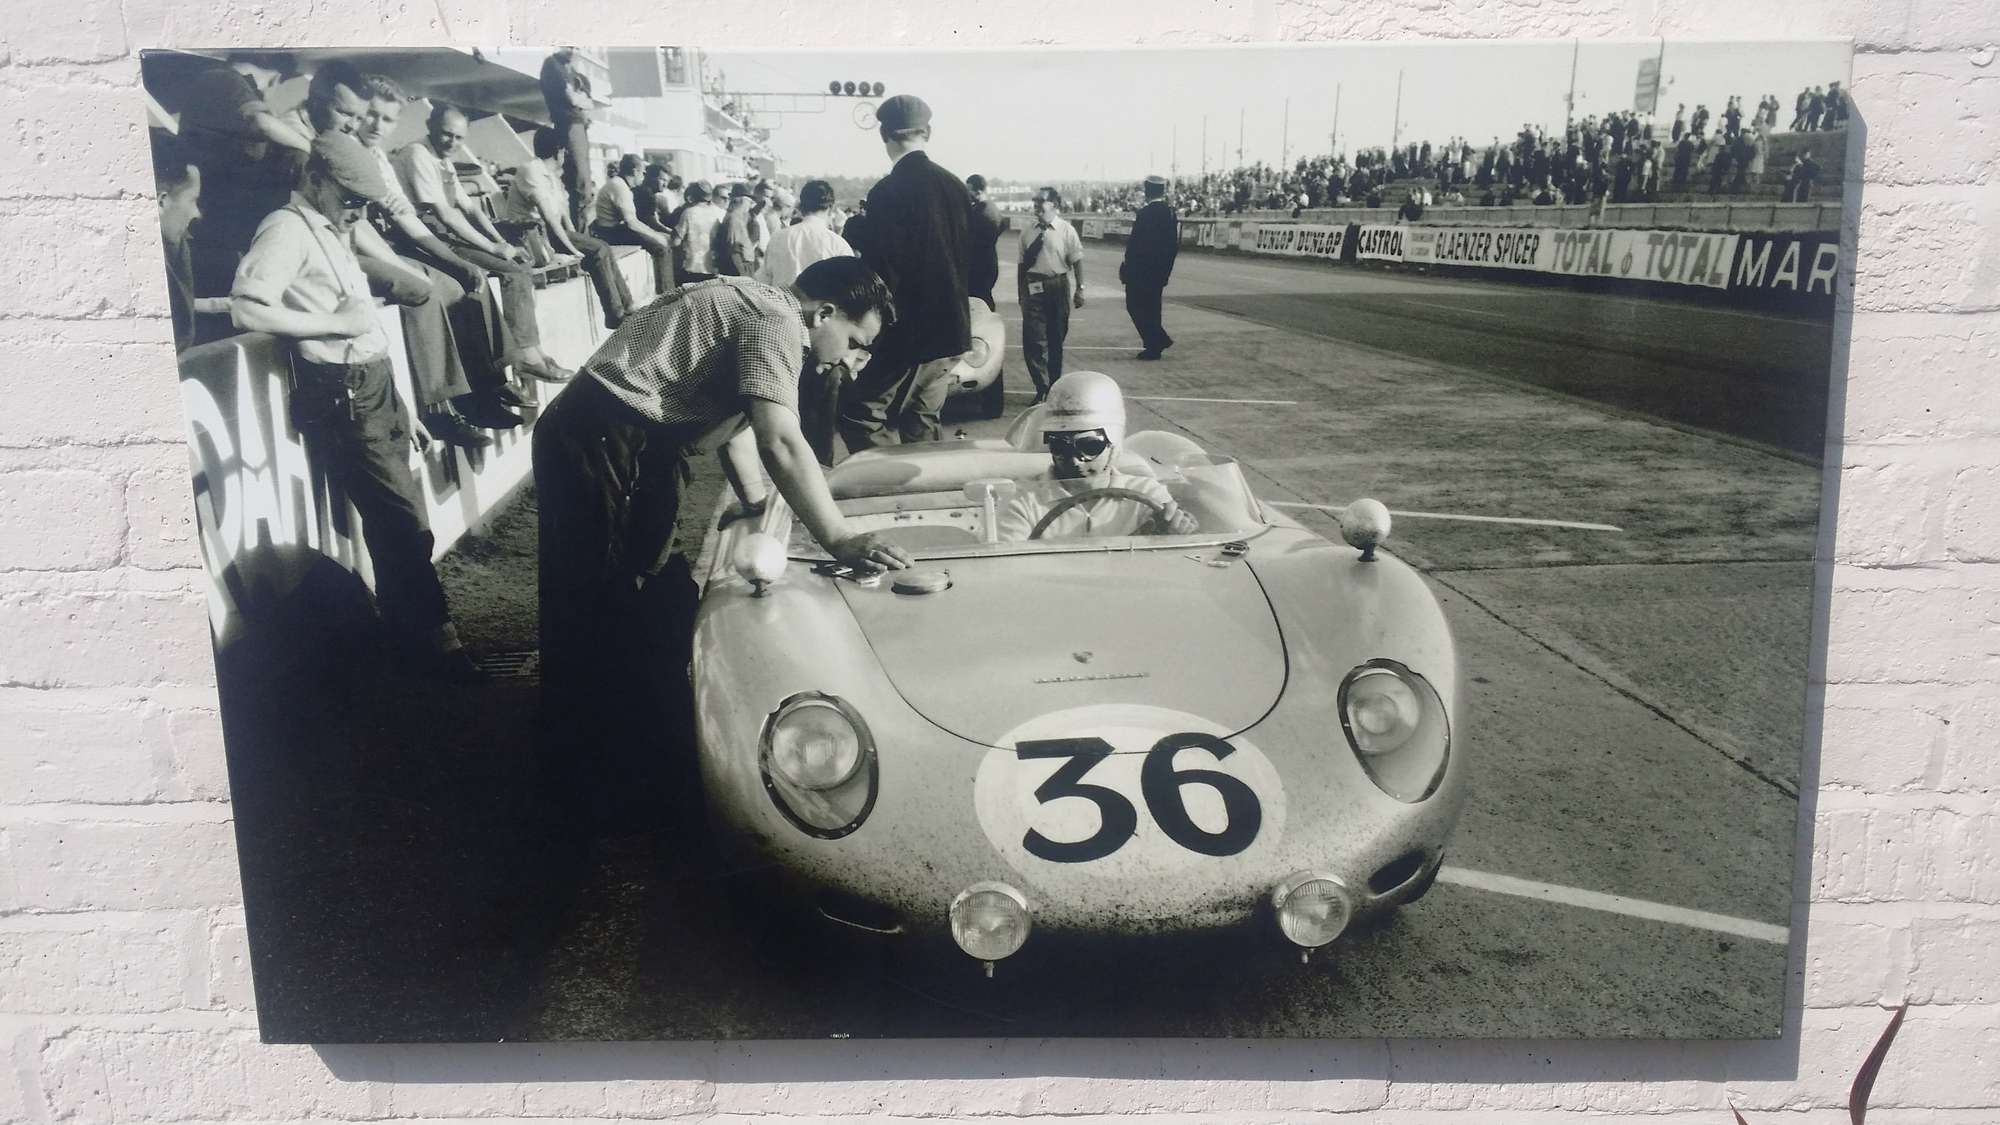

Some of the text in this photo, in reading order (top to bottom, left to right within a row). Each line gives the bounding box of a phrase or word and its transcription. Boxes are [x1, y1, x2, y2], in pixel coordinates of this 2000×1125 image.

[1257, 229, 1294, 250] DUNLOP
[1296, 230, 1342, 254] DUNLOP
[1358, 230, 1403, 257] CASTROL
[1435, 231, 1540, 265] GLAENZER SPICER
[1552, 231, 1614, 275] TOTAL
[1646, 233, 1729, 285] TOTAL
[1736, 239, 1839, 295] MAR
[1016, 731, 1262, 864] 36
